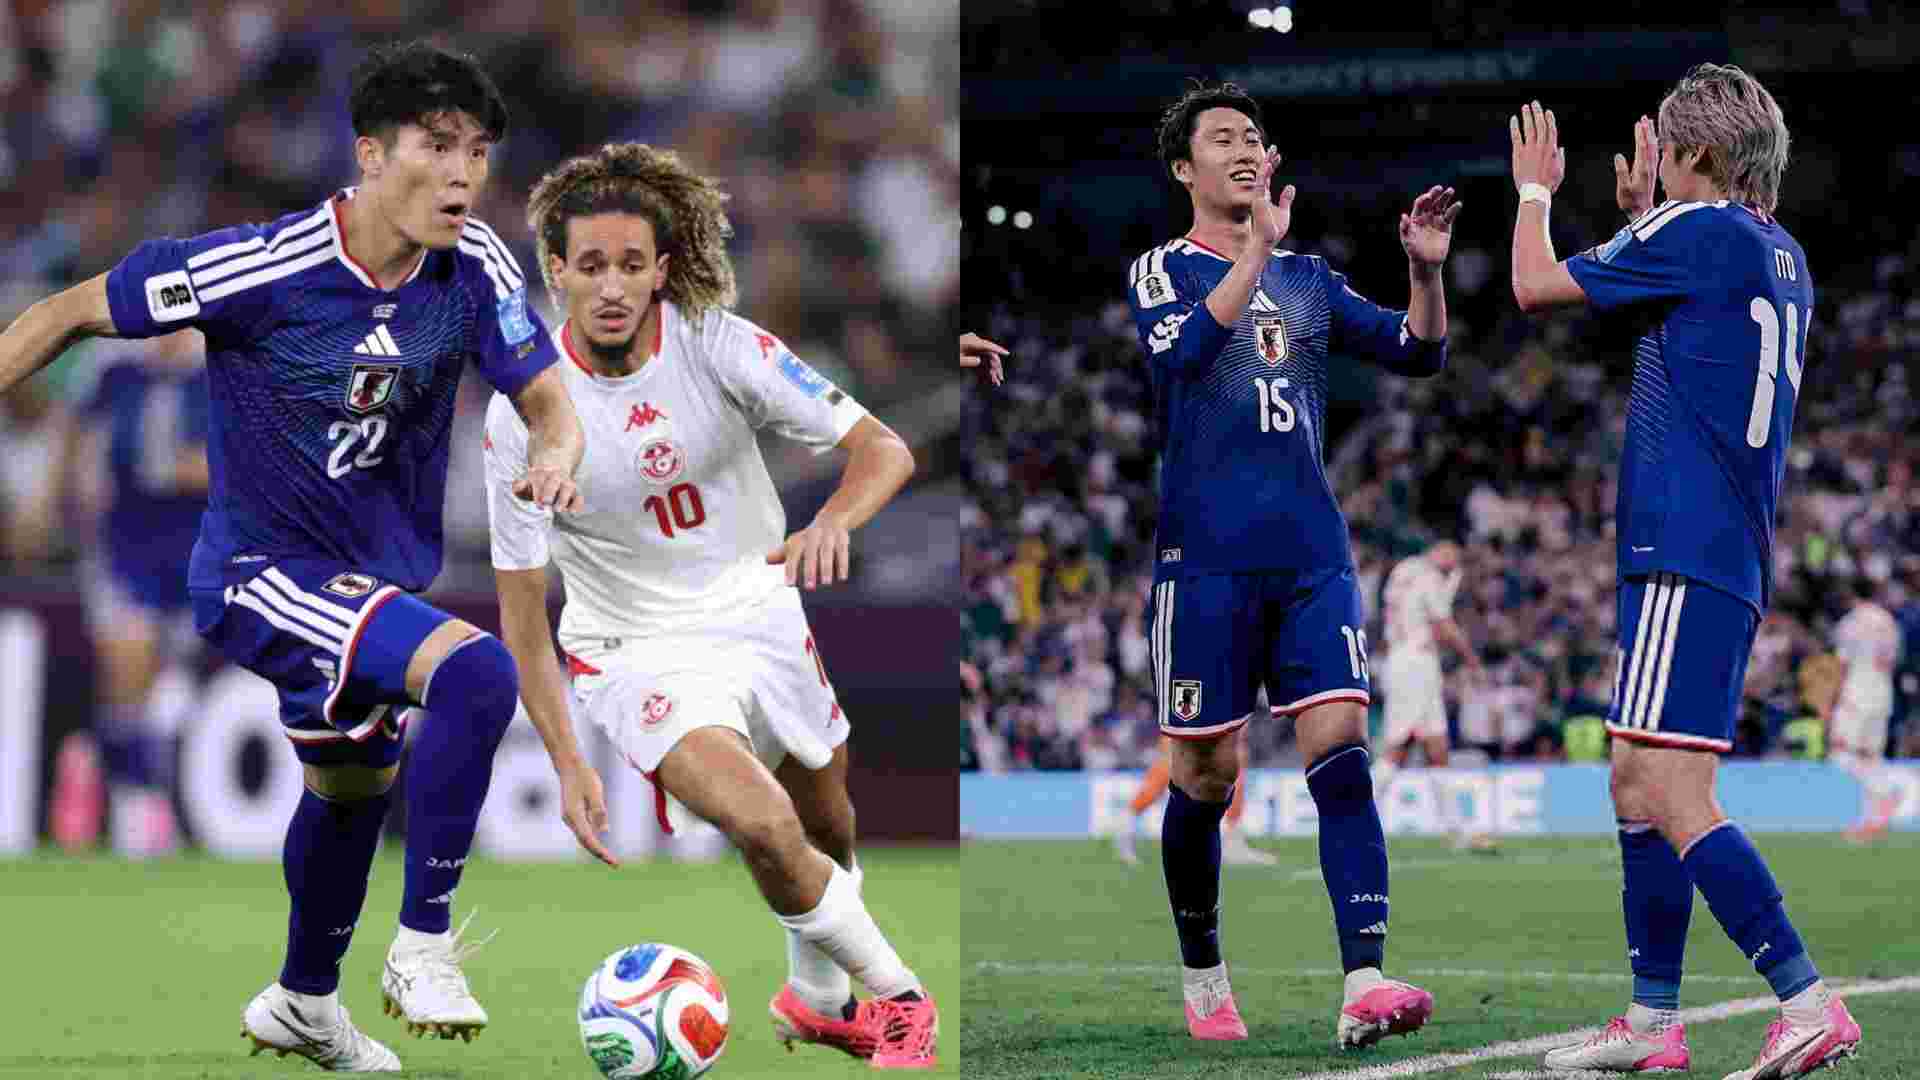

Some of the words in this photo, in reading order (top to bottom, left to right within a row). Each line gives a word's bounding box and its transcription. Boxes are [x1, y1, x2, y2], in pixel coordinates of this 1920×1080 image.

[1774, 248, 1796, 280] ITO
[1747, 297, 1812, 447] 14
[1255, 377, 1295, 432] 15
[327, 417, 387, 479] 22
[643, 483, 705, 538] 10
